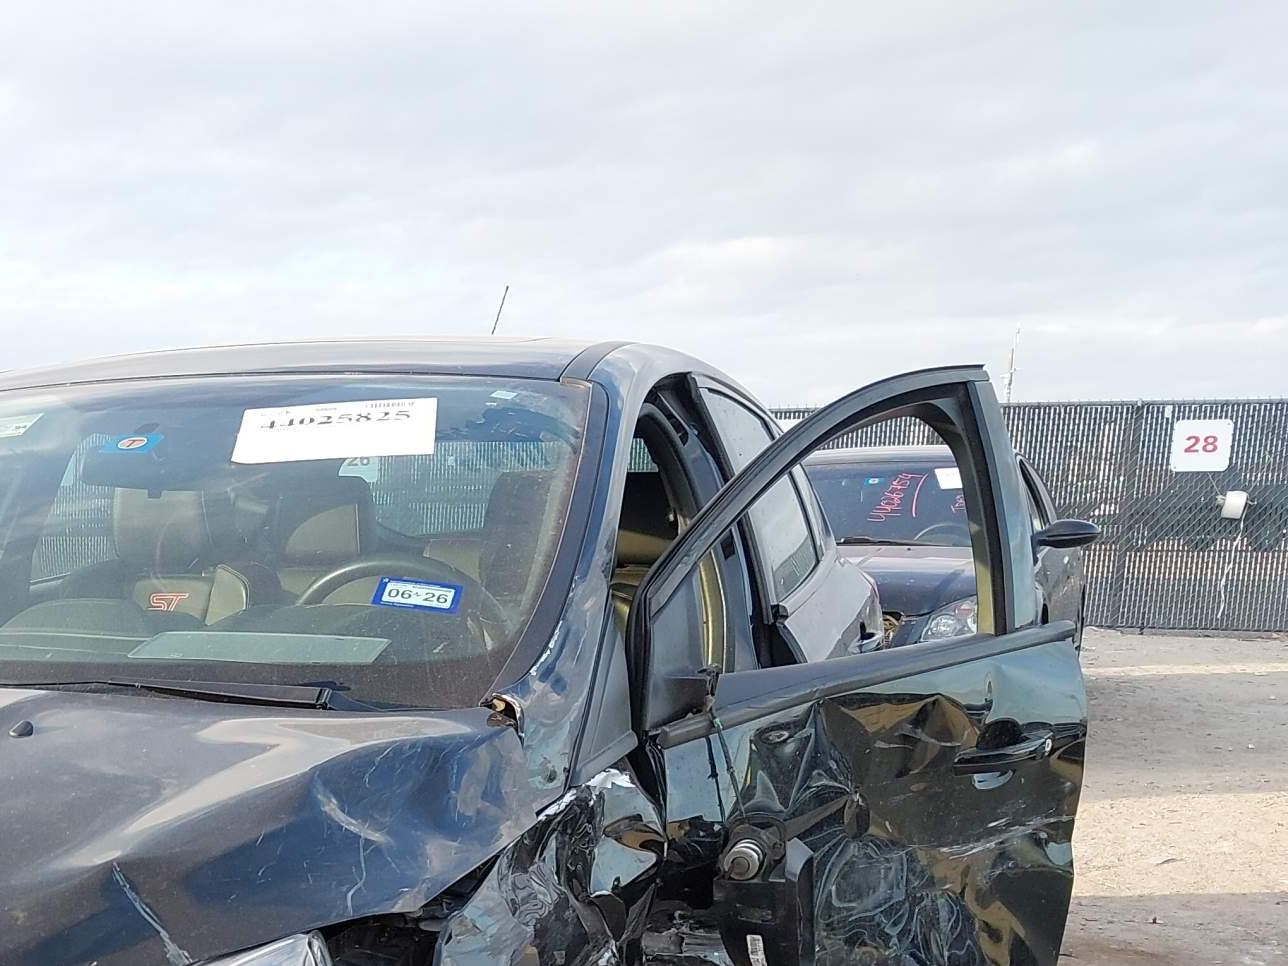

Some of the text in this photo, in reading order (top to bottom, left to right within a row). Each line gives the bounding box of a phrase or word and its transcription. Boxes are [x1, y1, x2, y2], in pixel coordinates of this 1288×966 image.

[1183, 435, 1219, 453] 28
[147, 592, 190, 612] ST
[387, 588, 413, 600] 06
[422, 592, 449, 604] 26
